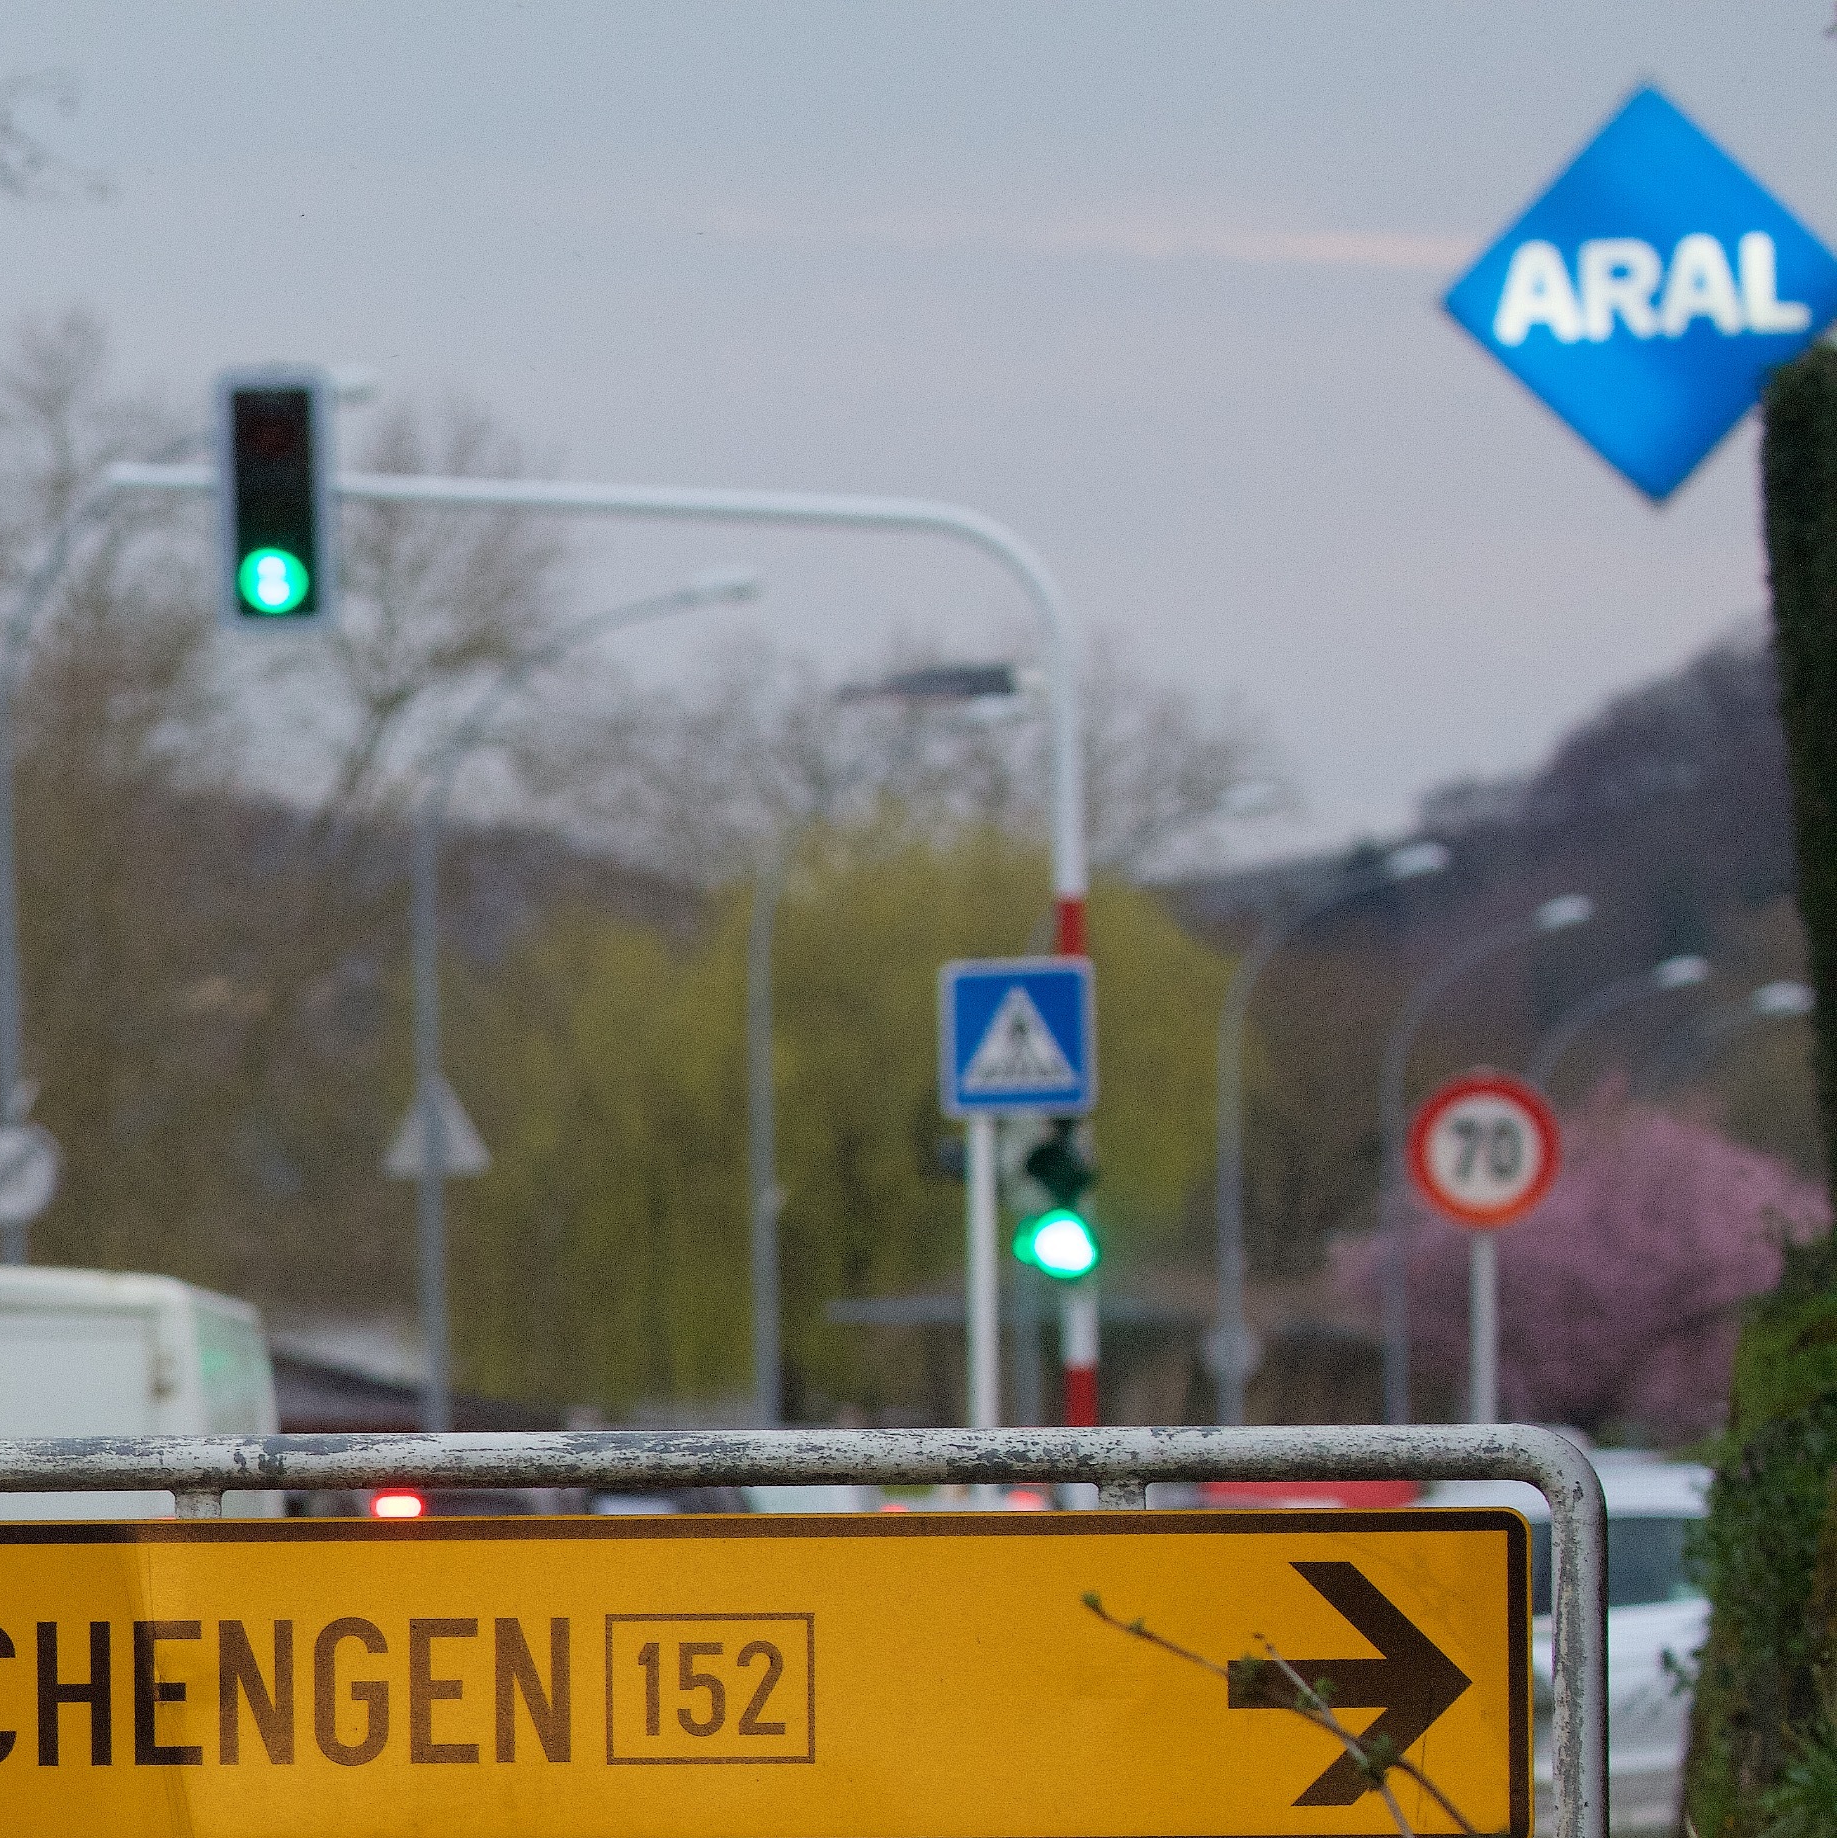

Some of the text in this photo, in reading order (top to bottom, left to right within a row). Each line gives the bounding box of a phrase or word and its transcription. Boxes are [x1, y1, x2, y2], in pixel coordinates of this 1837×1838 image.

[1493, 231, 1813, 347] ARAL
[1450, 1118, 1524, 1182] 70
[637, 1640, 786, 1738] 152
